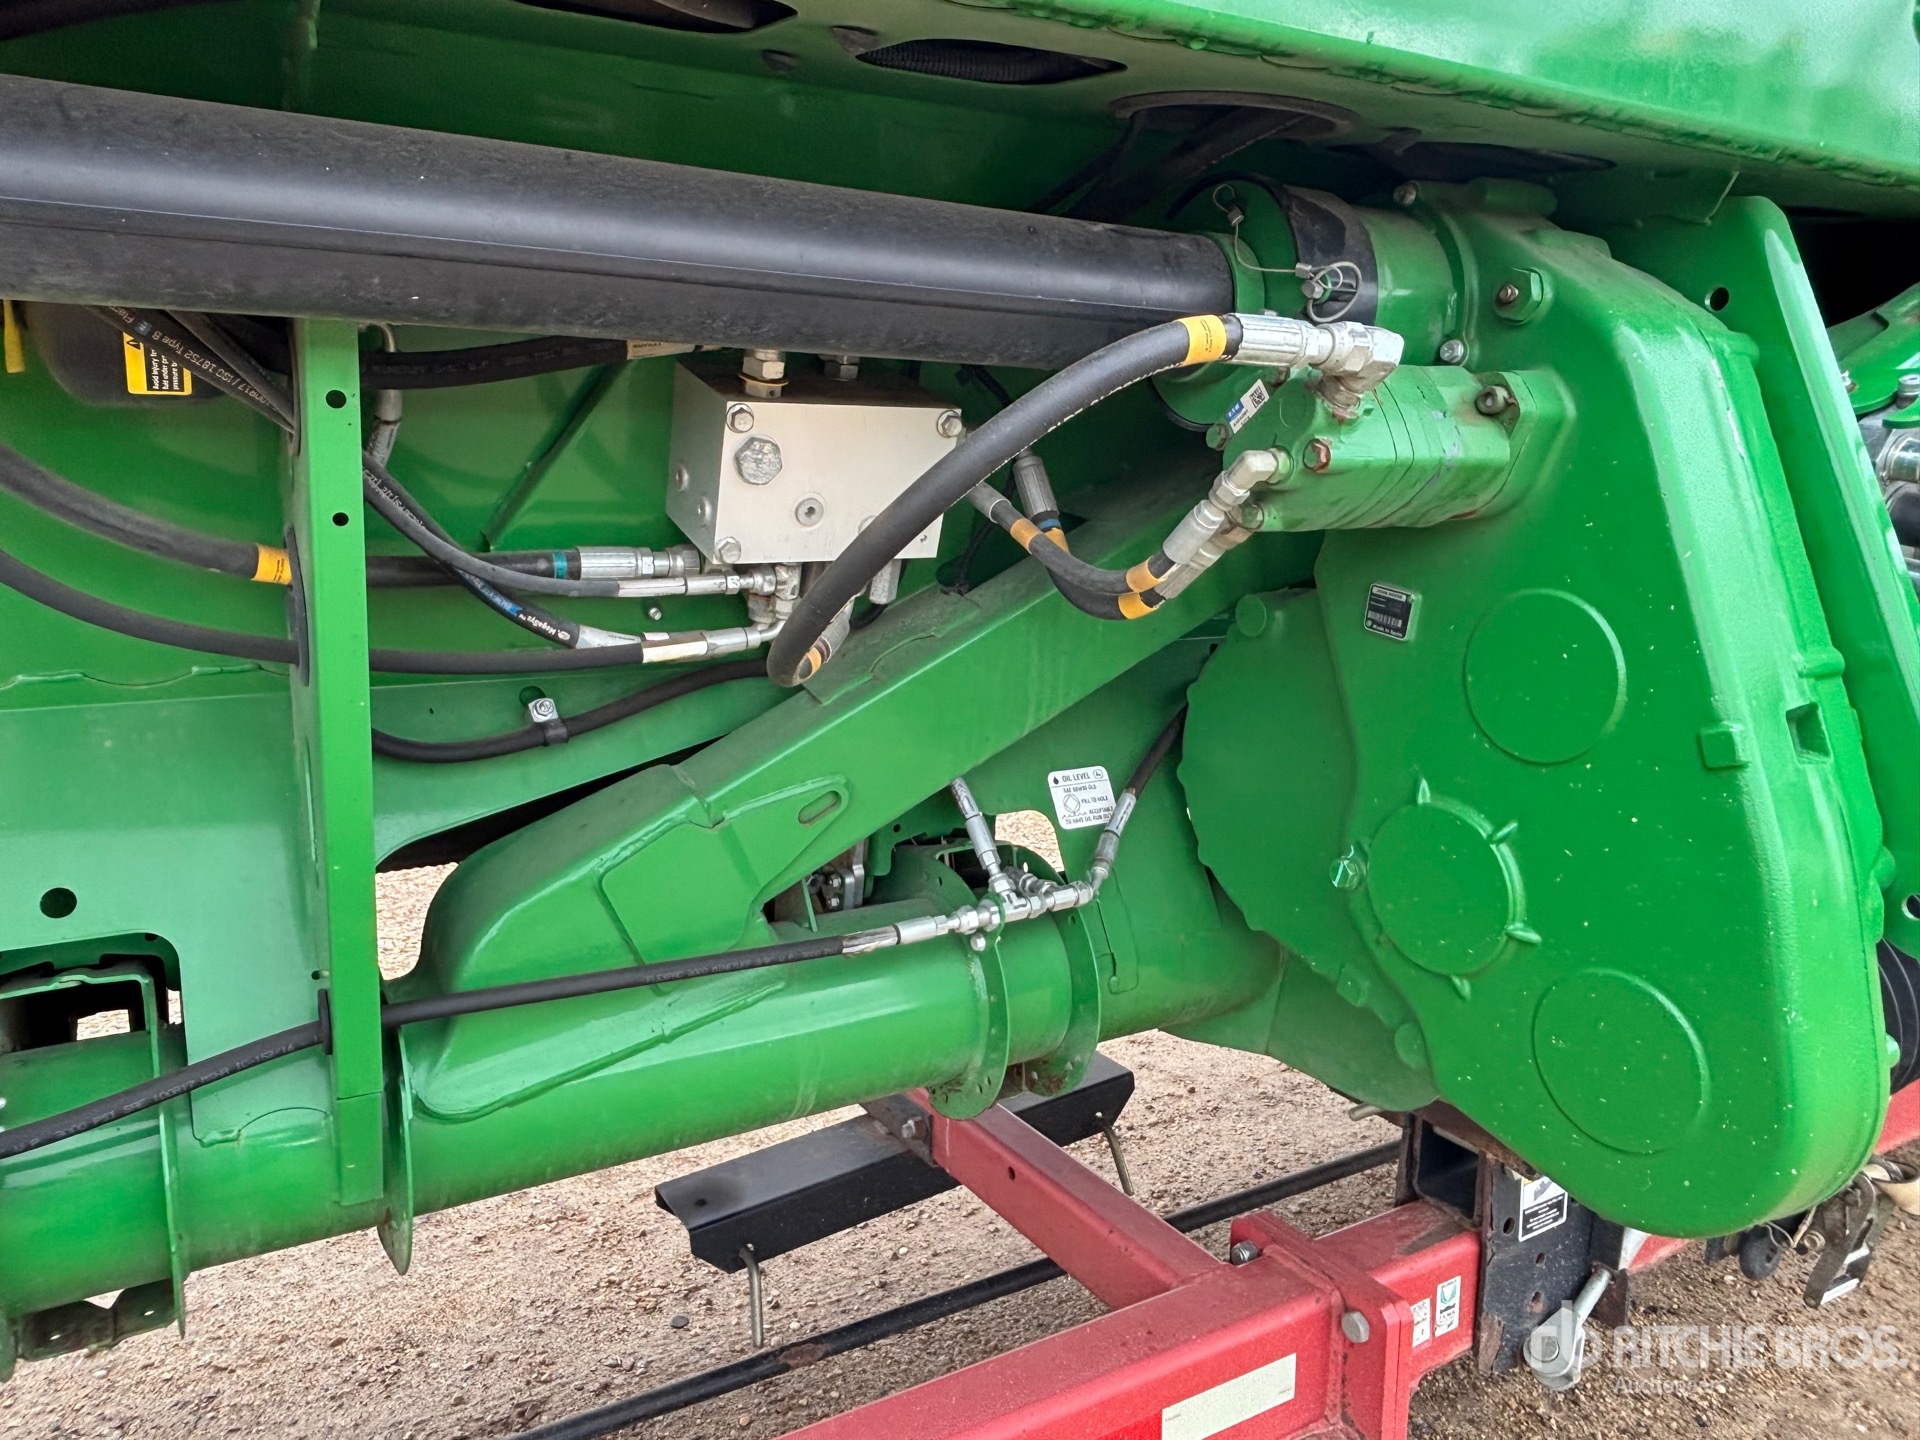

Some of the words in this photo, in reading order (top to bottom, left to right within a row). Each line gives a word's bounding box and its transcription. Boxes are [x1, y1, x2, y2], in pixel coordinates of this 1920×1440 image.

[152, 330, 162, 340] B
[162, 334, 184, 355] Type
[184, 348, 216, 374] 18752
[1072, 772, 1090, 781] LEVEL
